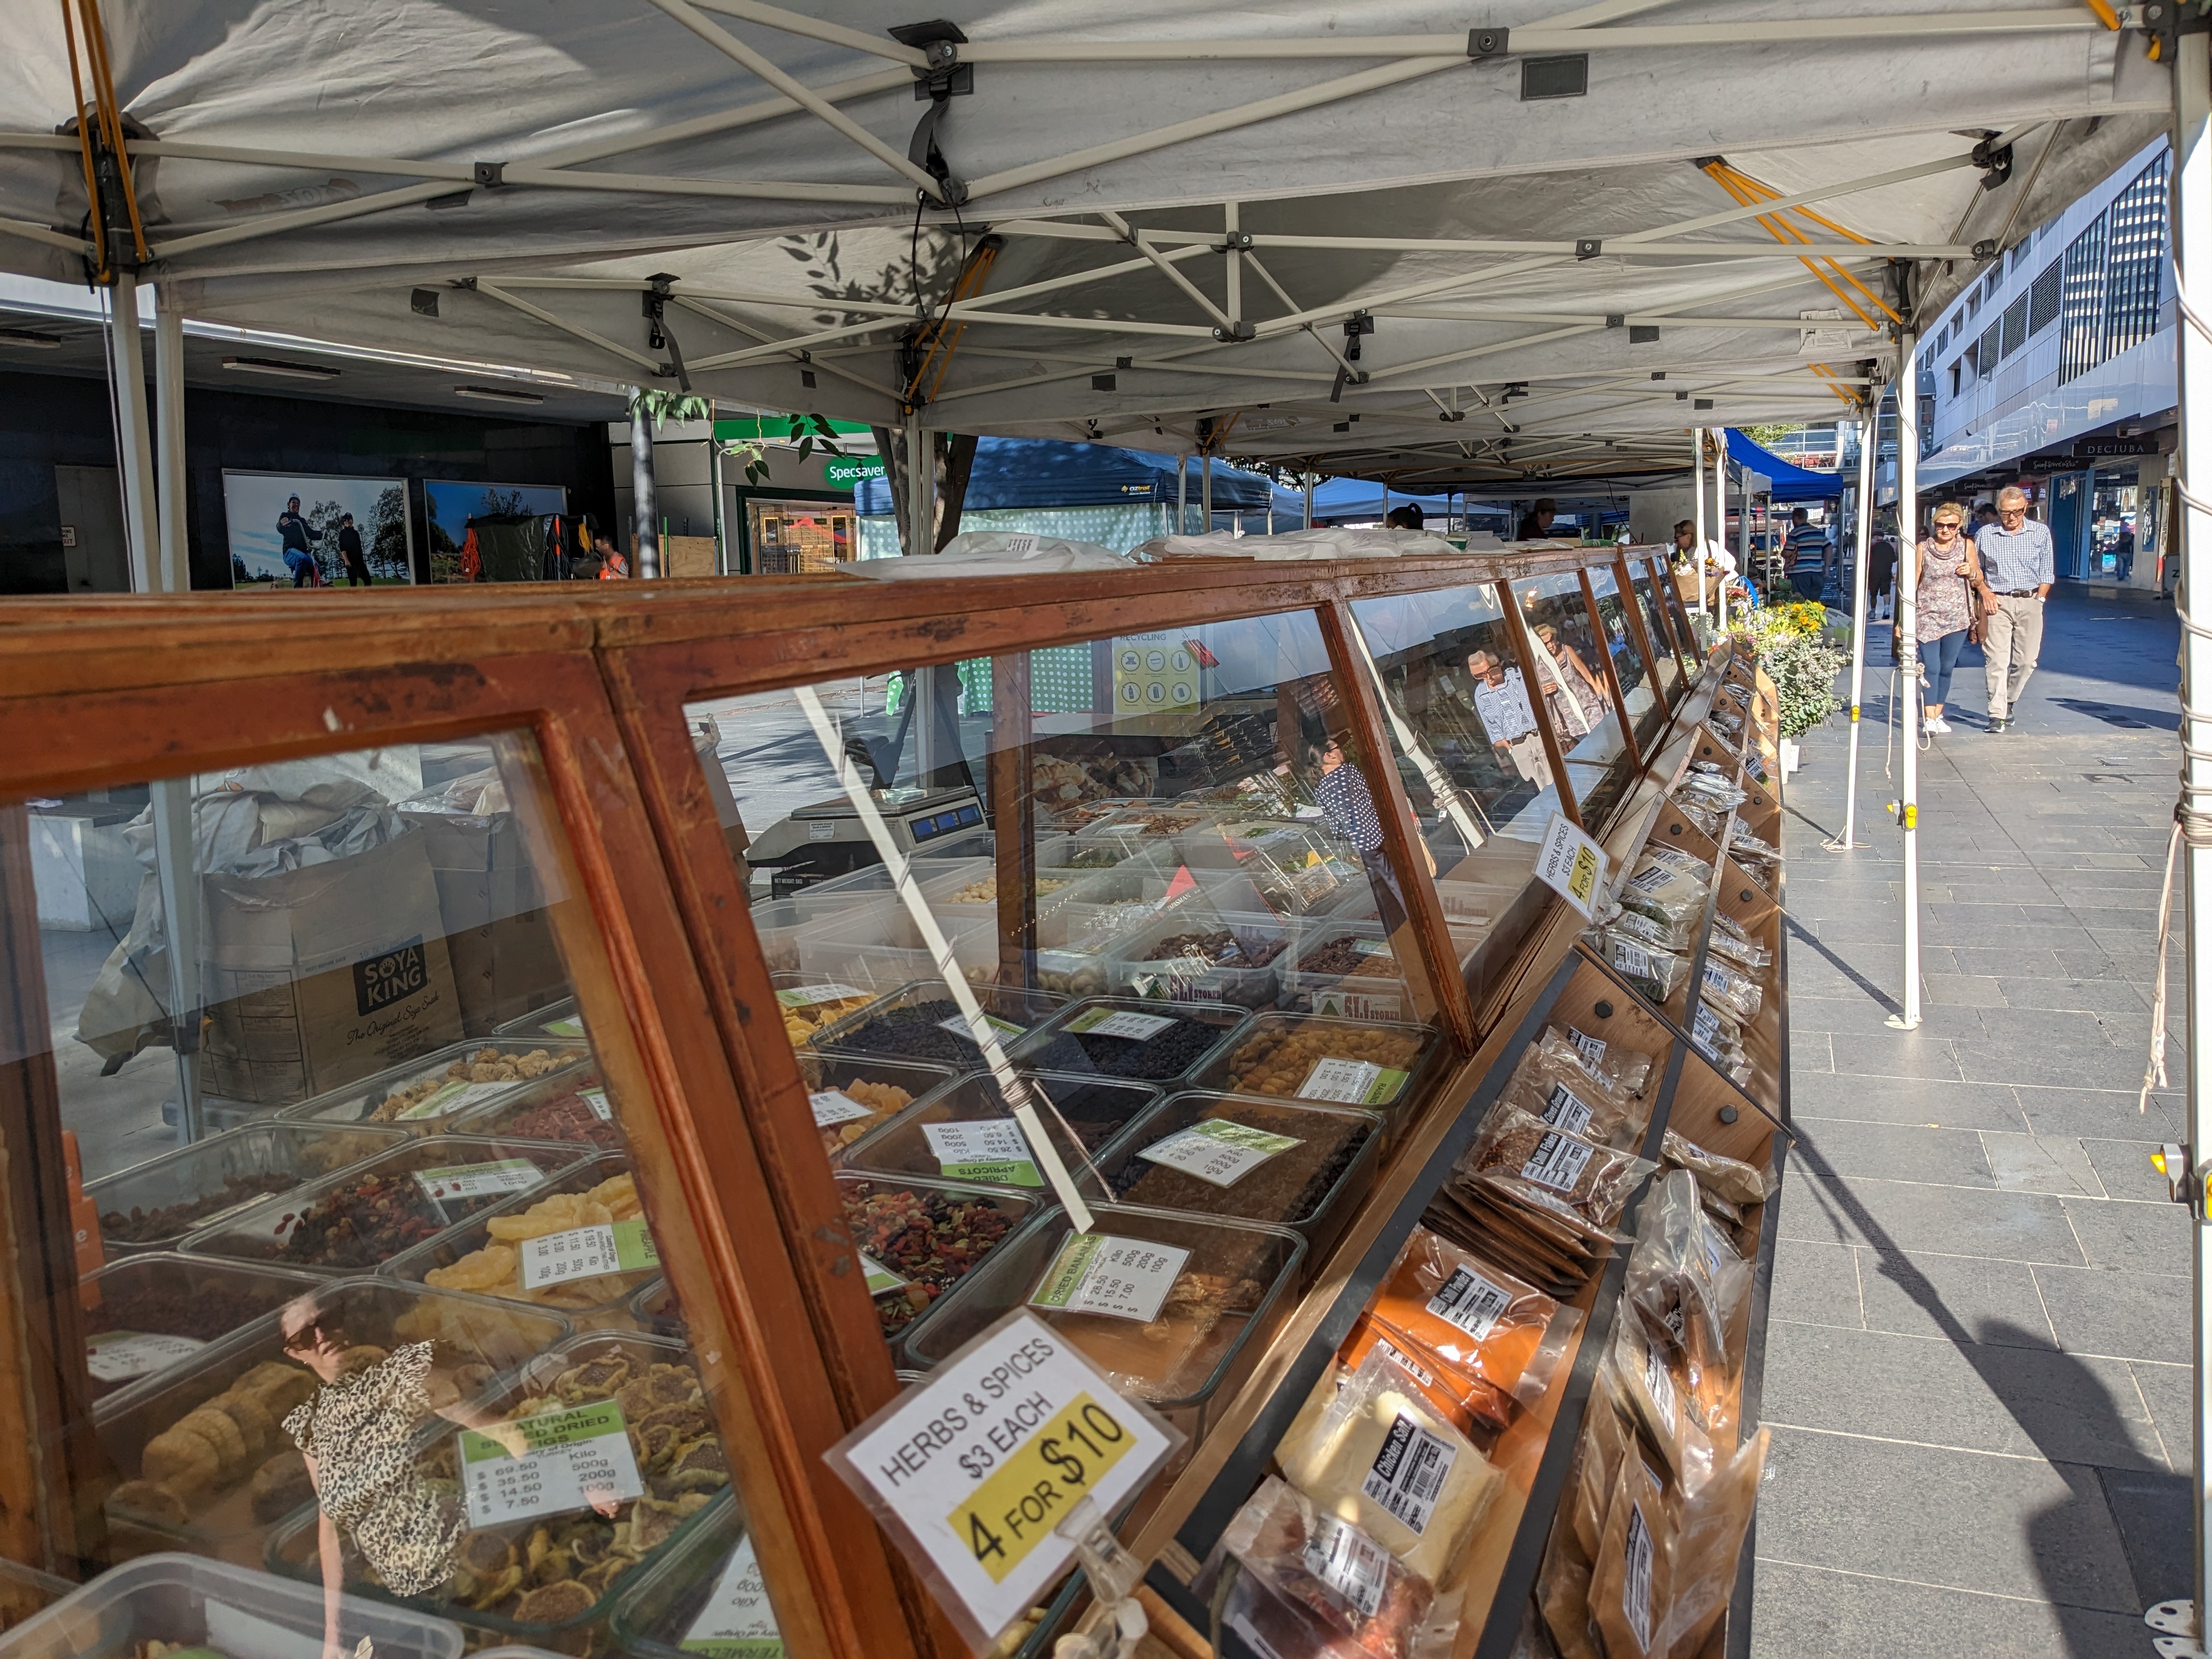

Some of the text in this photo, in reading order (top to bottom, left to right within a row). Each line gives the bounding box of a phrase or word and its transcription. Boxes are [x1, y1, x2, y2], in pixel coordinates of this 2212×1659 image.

[2087, 445, 2144, 454] DECJUBA
[830, 466, 885, 481] Specsaver
[1746, 759, 1757, 769] rsley
[1545, 855, 1559, 881] HERBS
[1555, 823, 1569, 850] SPICES
[1562, 845, 1576, 876] $3 EACH
[1572, 847, 1595, 899] 4 FOR $10
[365, 947, 419, 984] SOYA
[368, 966, 421, 1007] KING
[1194, 989, 1221, 999] STORER
[347, 1028, 365, 1045] The
[367, 1012, 402, 1036] Original
[404, 1005, 421, 1020] Soya
[1370, 1010, 1400, 1021] STORER
[1320, 1070, 1330, 1079] 3.00
[1328, 1089, 1342, 1100] 500g
[1342, 1092, 1352, 1101] Kilo
[1369, 1082, 1387, 1104] RAISINS
[1545, 1104, 1559, 1124] Cloves
[1219, 1153, 1240, 1164] 500g
[1532, 1133, 1559, 1166] Chilli Flakes
[958, 1165, 1015, 1175] APRICOTS
[1203, 1164, 1223, 1175] 100g
[1210, 1158, 1231, 1169] 200g
[538, 1245, 549, 1256] 3.00
[570, 1238, 580, 1250] 11.50
[585, 1235, 596, 1248] 19.50
[555, 1262, 567, 1275] 200g
[572, 1259, 583, 1272] 500g
[589, 1256, 599, 1266] Kilo
[1051, 1276, 1072, 1302] DRIED
[1069, 1235, 1097, 1274] BANANAS
[1150, 1257, 1168, 1273] 100g
[539, 1266, 551, 1279] 100g
[1076, 1269, 1091, 1290] Country
[1090, 1275, 1108, 1295] 28.50
[1110, 1249, 1124, 1262] Kilo
[1104, 1279, 1122, 1298] 15.50
[1122, 1249, 1141, 1266] 500g
[1119, 1283, 1135, 1300] 7.00
[1137, 1252, 1155, 1269] 200g
[1440, 1272, 1471, 1304] Chilli Powder
[880, 1338, 1054, 1486] HERBS & SPICES
[481, 1415, 610, 1449] SLED DRIED
[959, 1391, 1054, 1479] $3 EACH
[1377, 1419, 1413, 1478] Chicken Salt.
[477, 1449, 597, 1480] $ 69.50 Kilo
[478, 1458, 609, 1491] $ 35.50 500g
[479, 1469, 616, 1503] $ 14.50 200g
[969, 1403, 1123, 1561] 4 FOR $10
[481, 1481, 614, 1514] $ 7.50 100g
[737, 1579, 766, 1593] 00g
[731, 1597, 759, 1607] Kilo
[712, 1629, 745, 1639] Origin:
